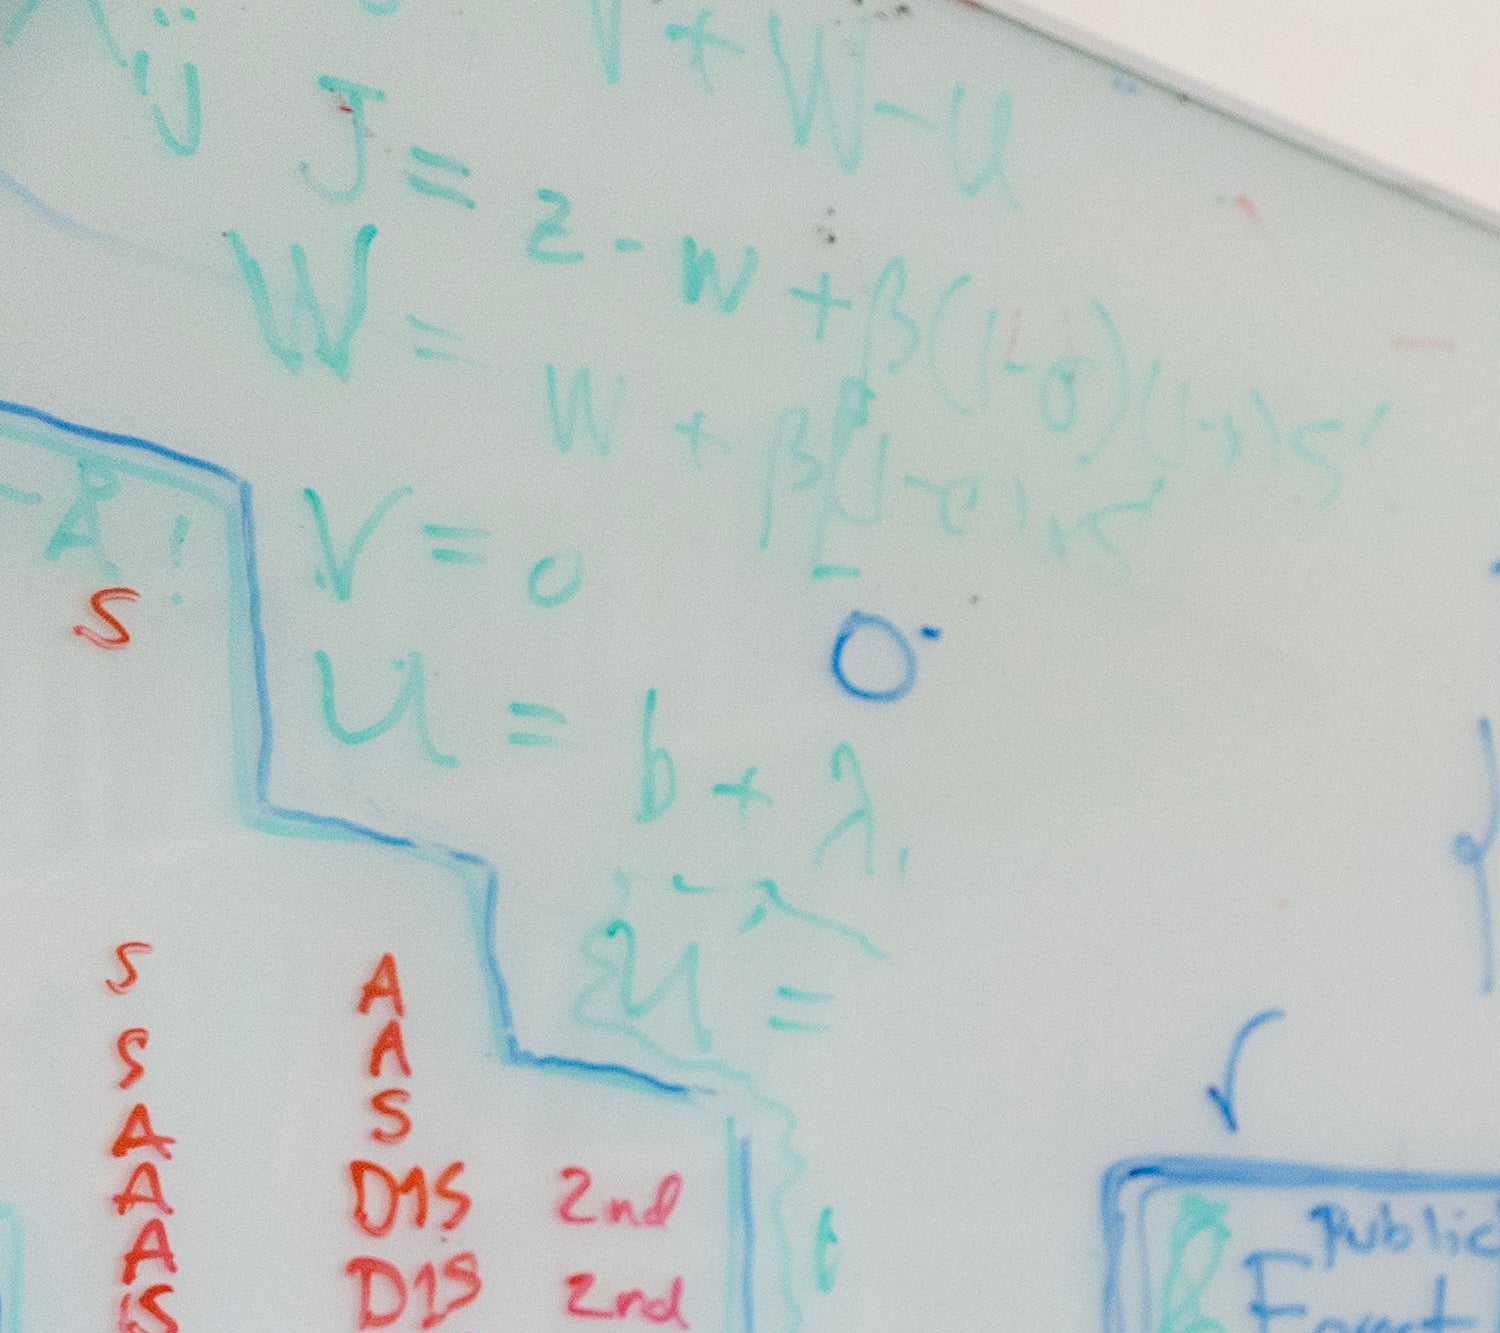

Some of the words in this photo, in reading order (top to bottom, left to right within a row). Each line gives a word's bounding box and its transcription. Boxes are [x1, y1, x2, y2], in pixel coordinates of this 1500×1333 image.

[357, 953, 406, 1018] A
[367, 1020, 412, 1078] A
[109, 1104, 177, 1161] A
[369, 1087, 413, 1144] S
[111, 1162, 174, 1216] A
[556, 1166, 684, 1232] 2nd
[121, 1218, 178, 1286] A
[562, 1271, 690, 1333] 2nd
